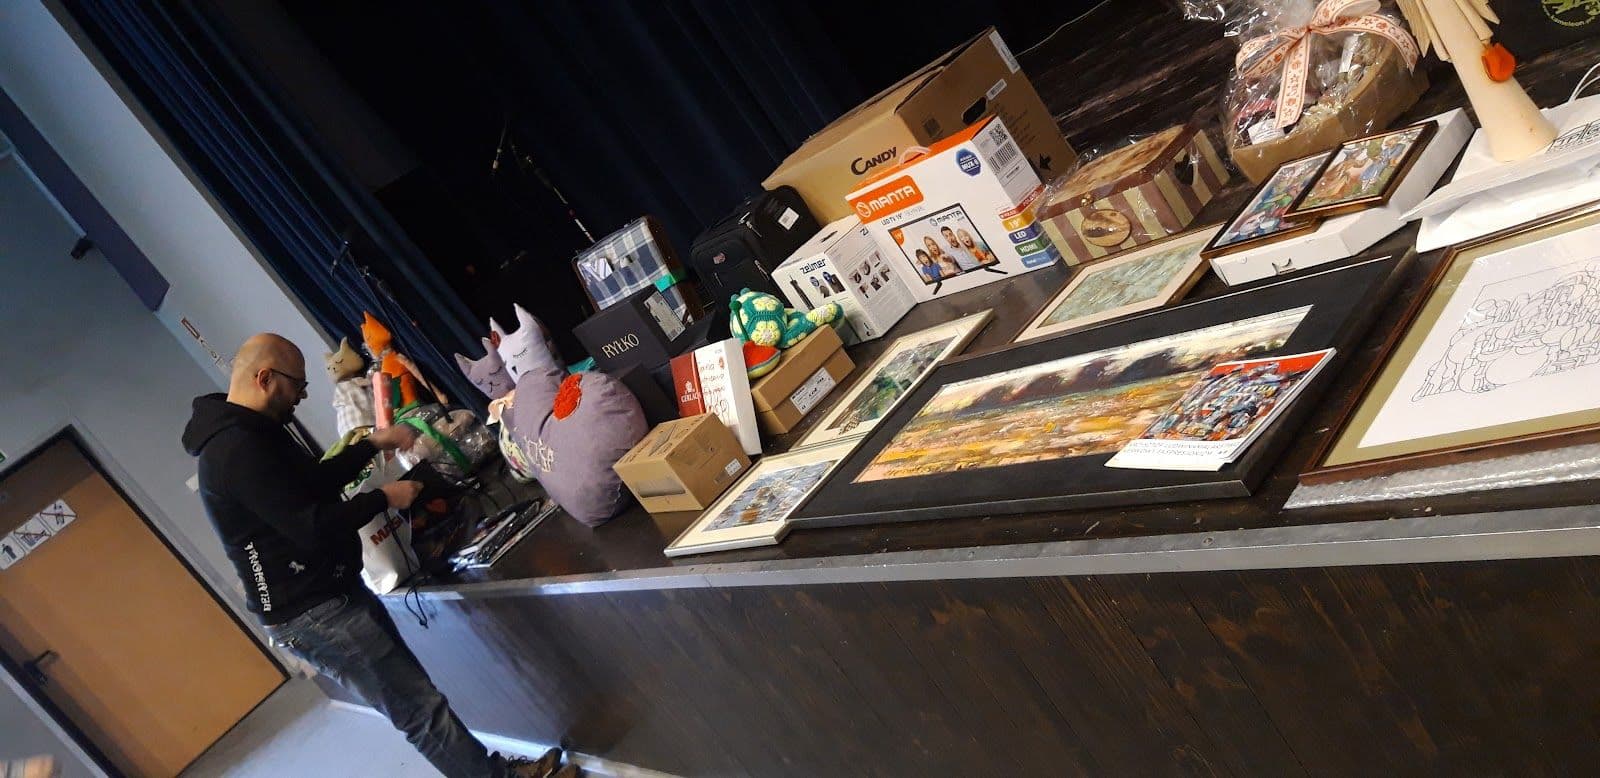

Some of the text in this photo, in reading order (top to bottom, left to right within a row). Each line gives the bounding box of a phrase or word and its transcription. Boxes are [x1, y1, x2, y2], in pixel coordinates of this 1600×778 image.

[850, 147, 897, 175] CANDY
[869, 185, 916, 211] MANTA
[936, 210, 962, 223] MANTA
[1014, 230, 1026, 240] LED
[799, 259, 826, 274] zelmer
